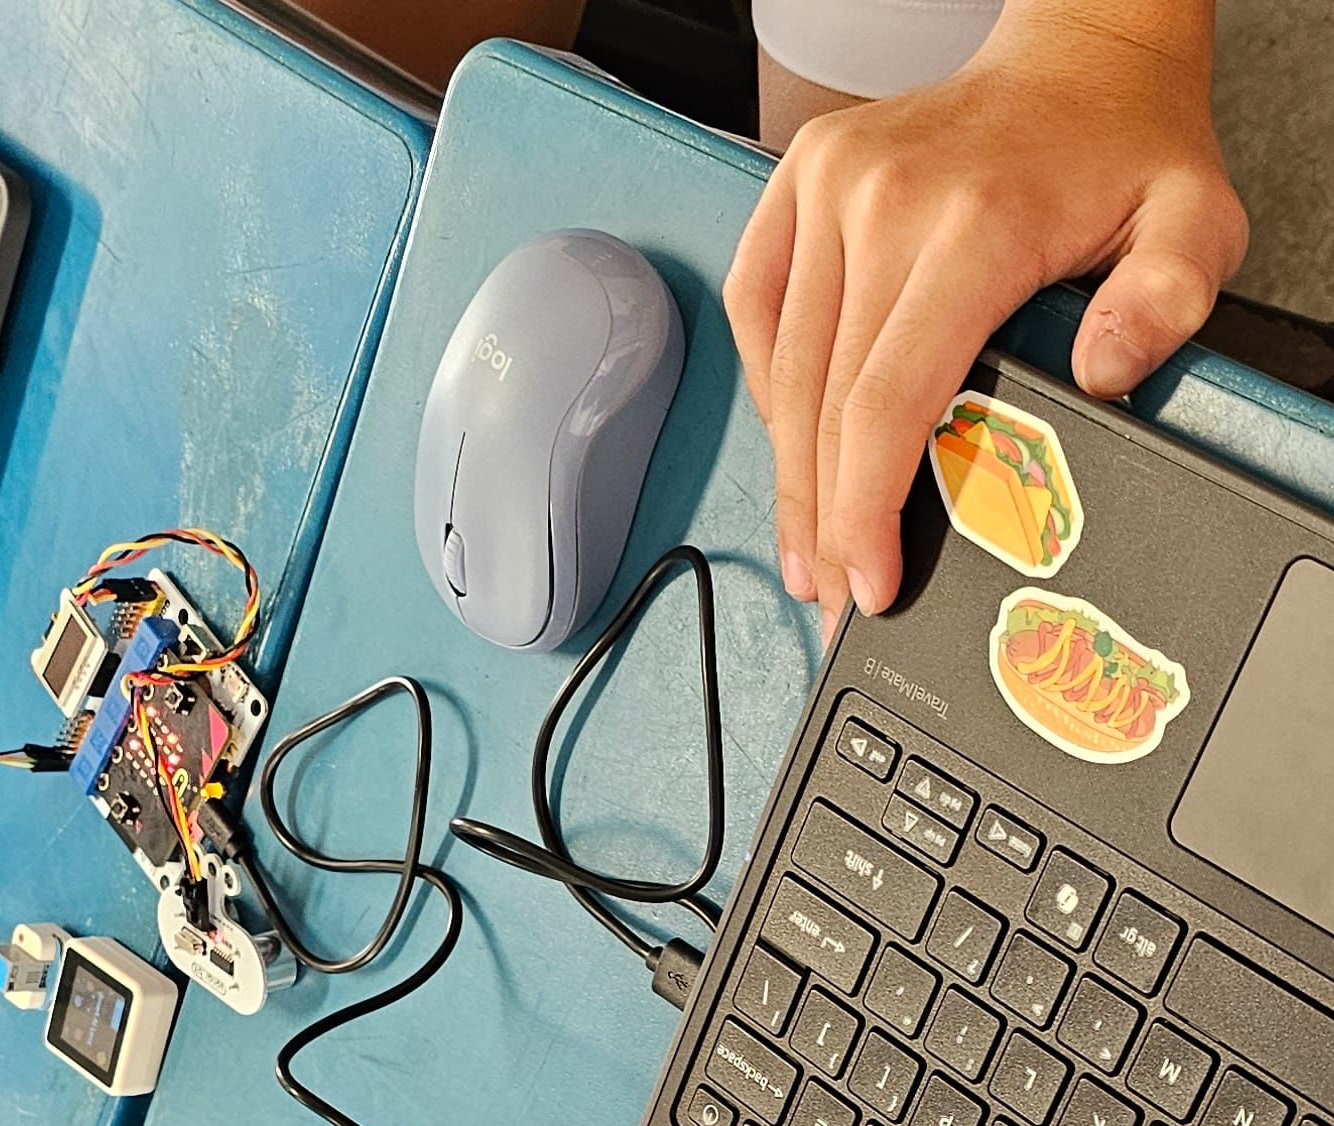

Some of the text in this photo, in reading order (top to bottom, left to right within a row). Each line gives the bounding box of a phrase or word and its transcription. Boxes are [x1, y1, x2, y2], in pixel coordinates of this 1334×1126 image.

[473, 332, 514, 383] logi
[838, 845, 876, 881] shift
[785, 905, 824, 940] enter
[1117, 921, 1159, 962] alt gr
[1021, 1065, 1038, 1091] L
[1155, 1054, 1184, 1084] M
